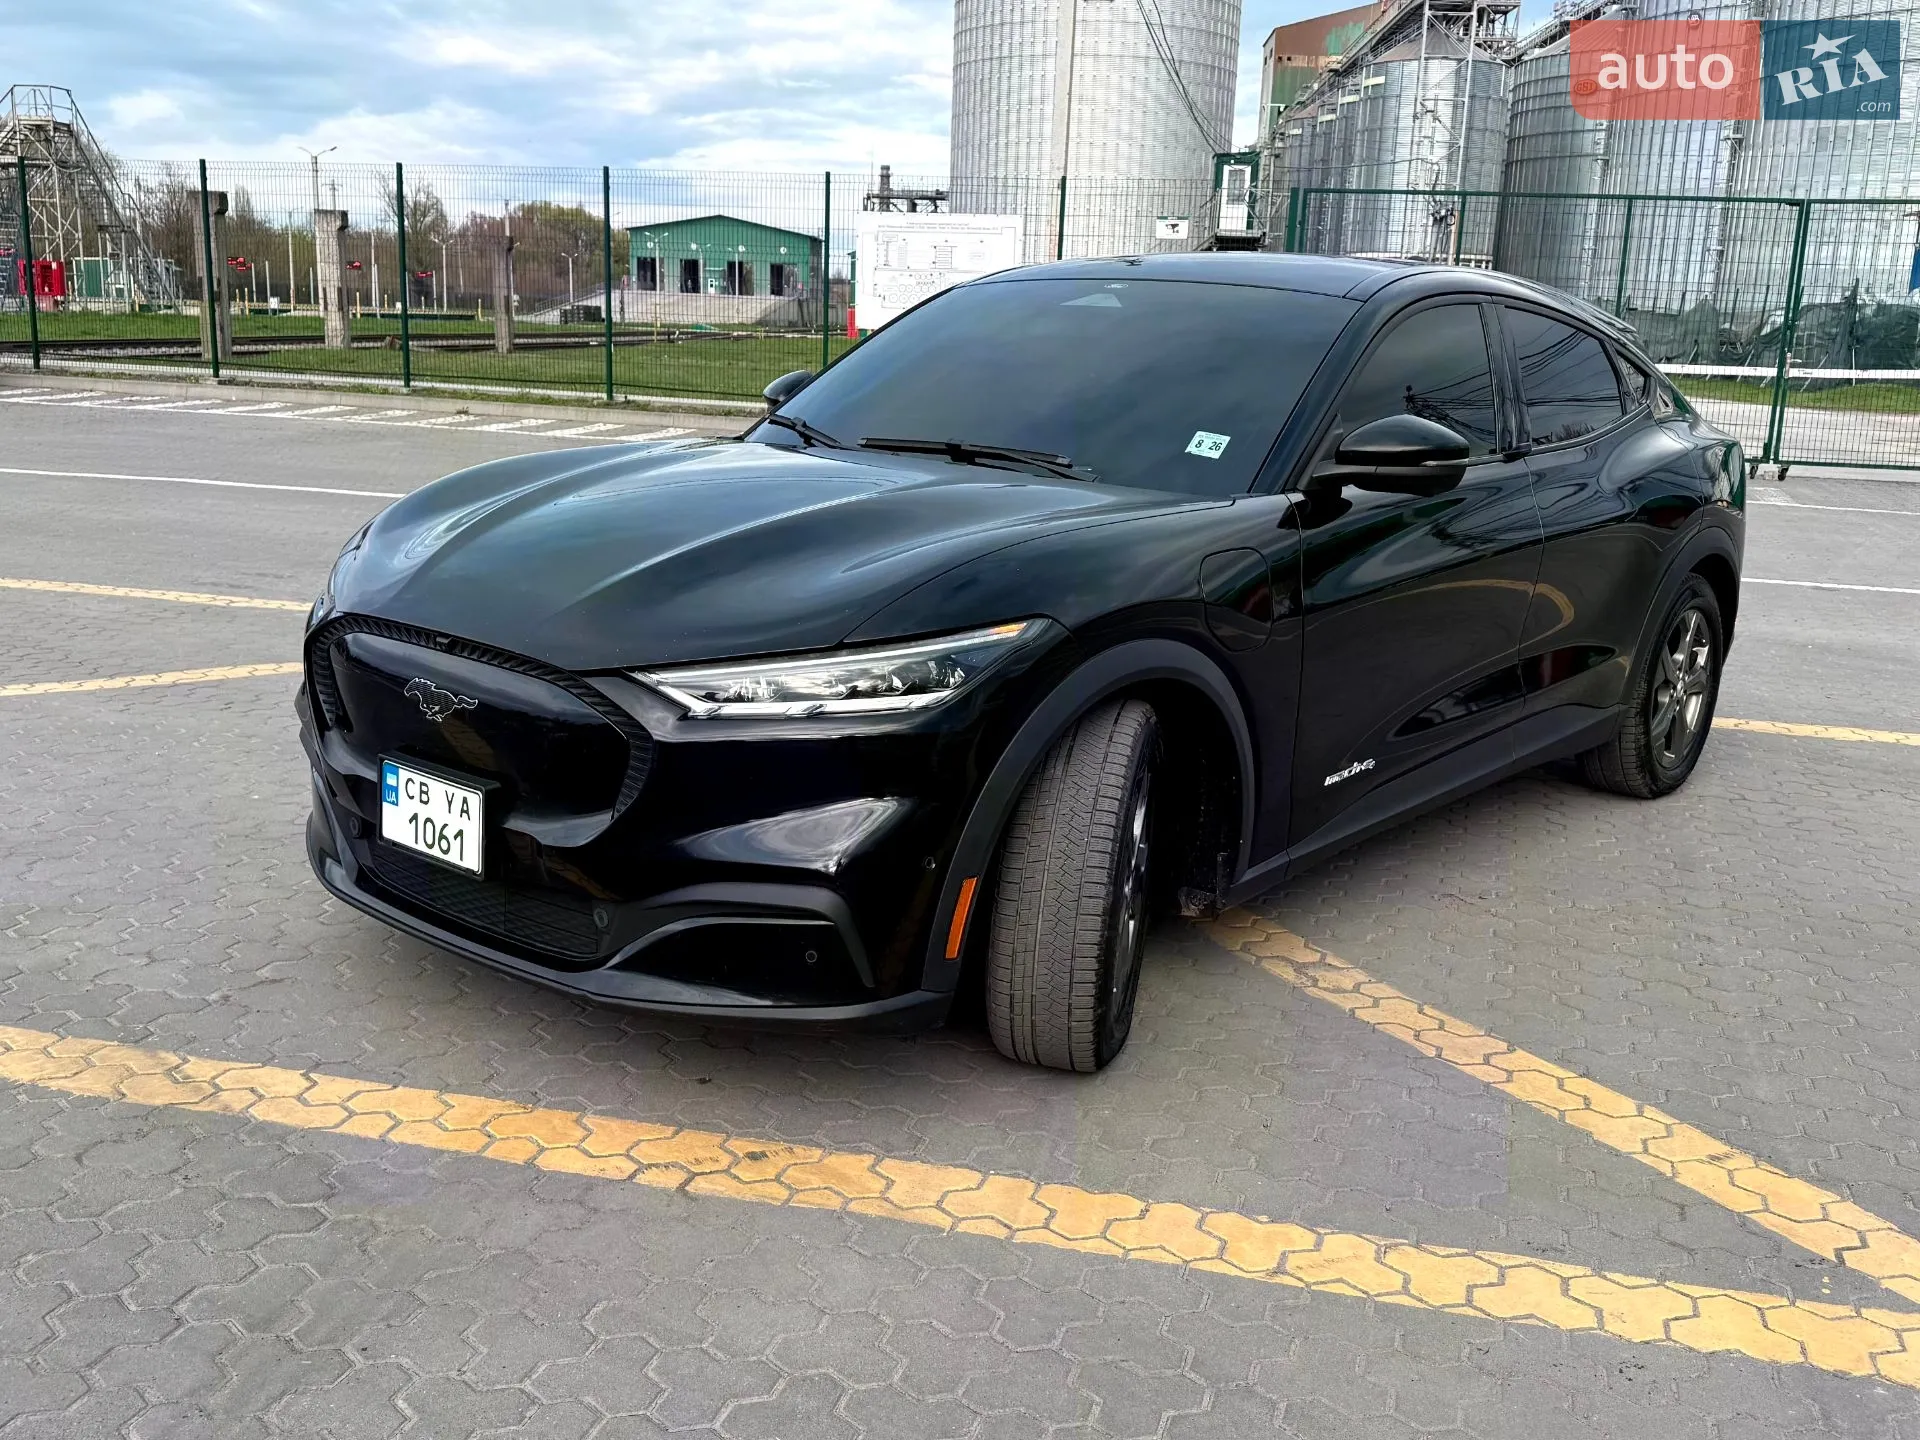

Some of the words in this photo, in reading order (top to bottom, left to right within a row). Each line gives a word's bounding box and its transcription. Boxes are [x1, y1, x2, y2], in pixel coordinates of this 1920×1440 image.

[1195, 439, 1204, 448] 8
[1208, 441, 1222, 451] 26
[385, 789, 397, 804] UA
[404, 777, 430, 805] CB
[445, 789, 471, 821] YA
[408, 812, 464, 861] 1061
